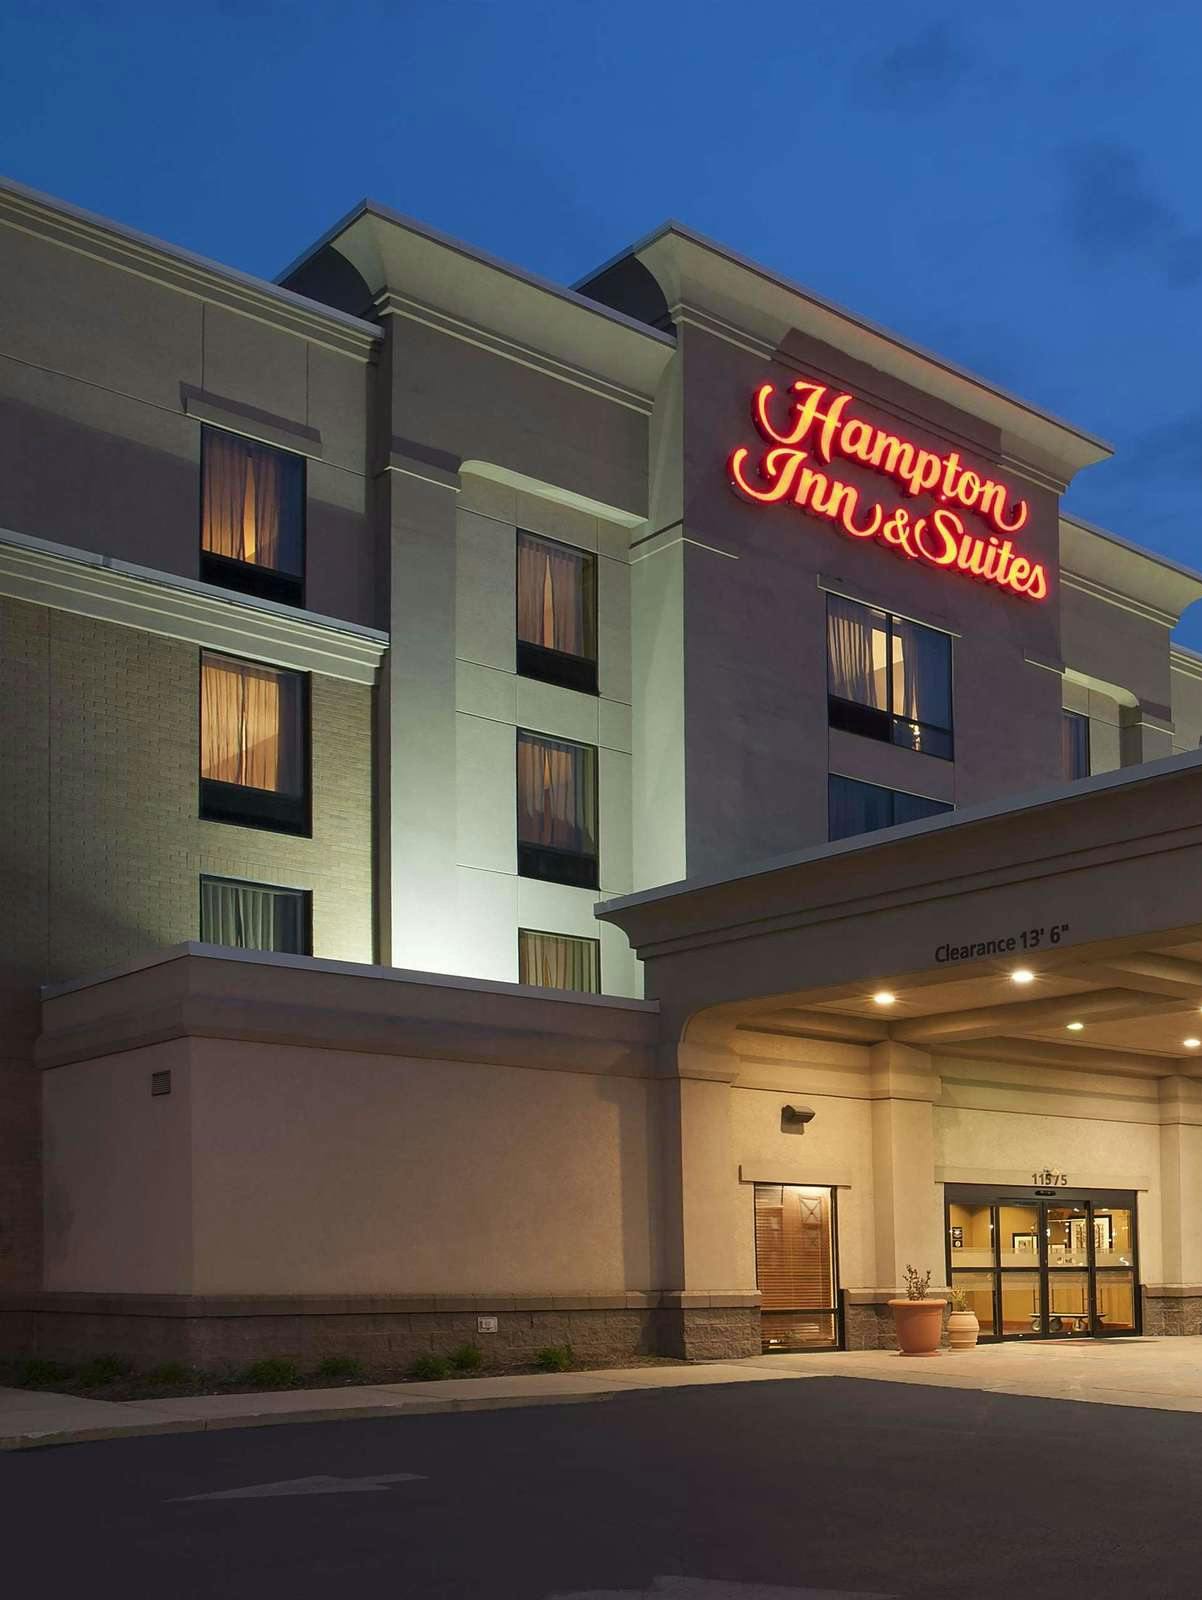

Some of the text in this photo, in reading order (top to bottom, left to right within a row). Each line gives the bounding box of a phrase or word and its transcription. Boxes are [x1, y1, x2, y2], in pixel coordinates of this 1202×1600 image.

[757, 380, 1029, 532] Hampton
[731, 448, 1048, 599] Inn & Suites
[934, 923, 1070, 963] Clearance 13' 6"
[1031, 1172, 1068, 1186] 11575
